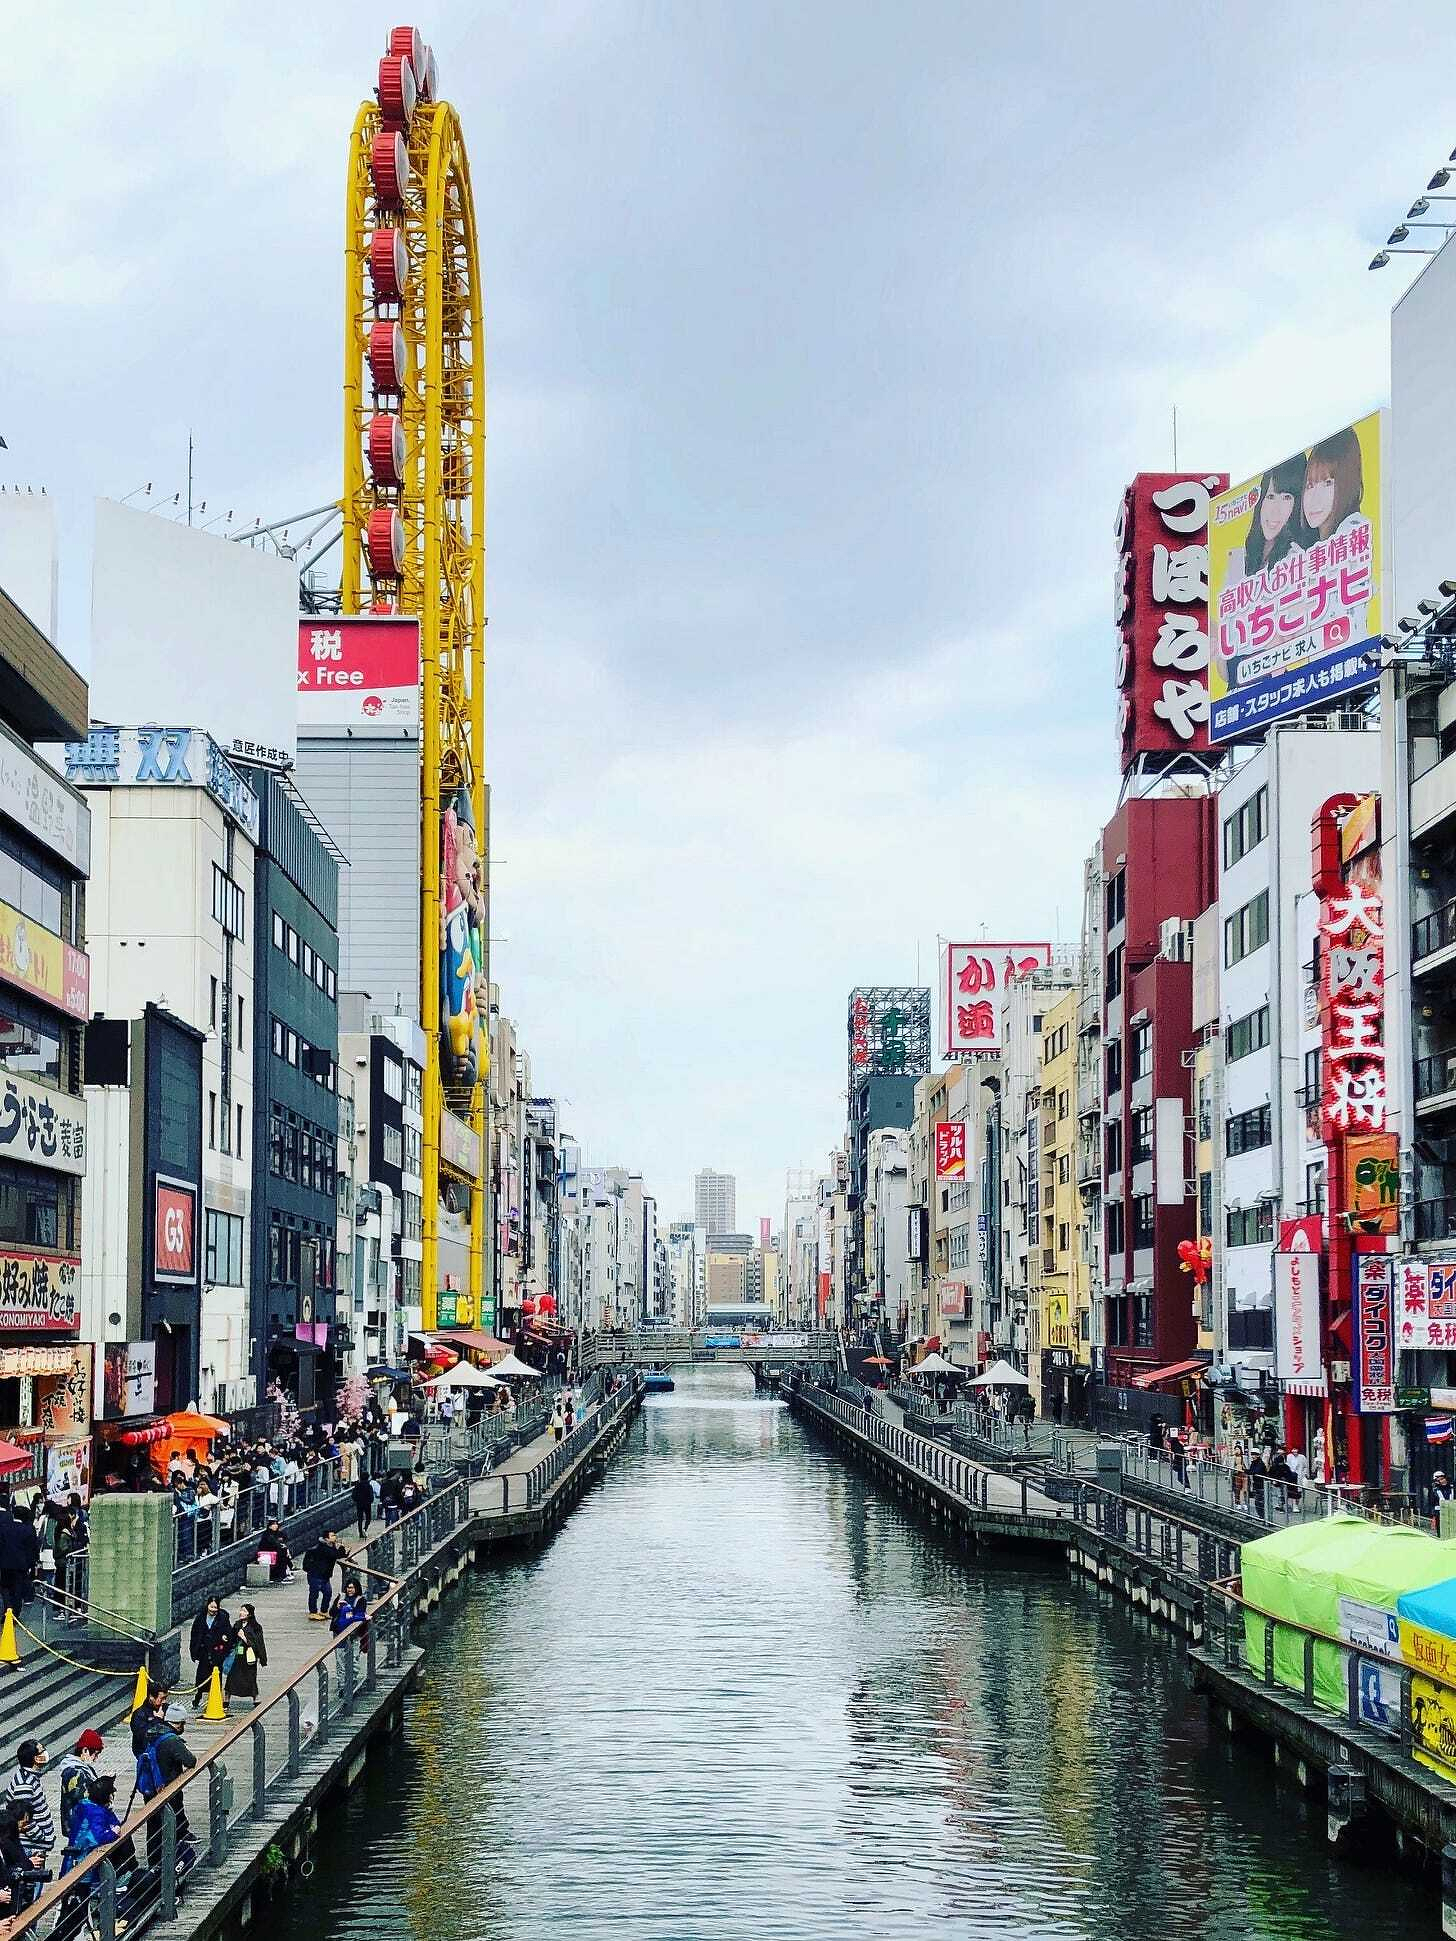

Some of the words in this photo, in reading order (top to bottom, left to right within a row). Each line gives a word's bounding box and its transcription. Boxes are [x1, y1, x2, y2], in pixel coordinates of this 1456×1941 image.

[1220, 524, 1369, 617] 高収入お仕事情報
[1153, 476, 1220, 739] づぼらや
[1221, 554, 1370, 656] いちごナビ
[310, 630, 342, 660] 税
[1241, 646, 1292, 678] いちごナビ
[1295, 636, 1317, 656] 求人
[316, 666, 364, 685] Free
[232, 738, 289, 762] 意匠作成中
[1326, 884, 1384, 1128] 大阪王将
[939, 1130, 949, 1167] ドラッグ
[950, 1125, 963, 1159] ツルハ
[1404, 1267, 1426, 1315] 薬
[1364, 1285, 1387, 1351] ダイコク
[1361, 1388, 1391, 1401] 免税
